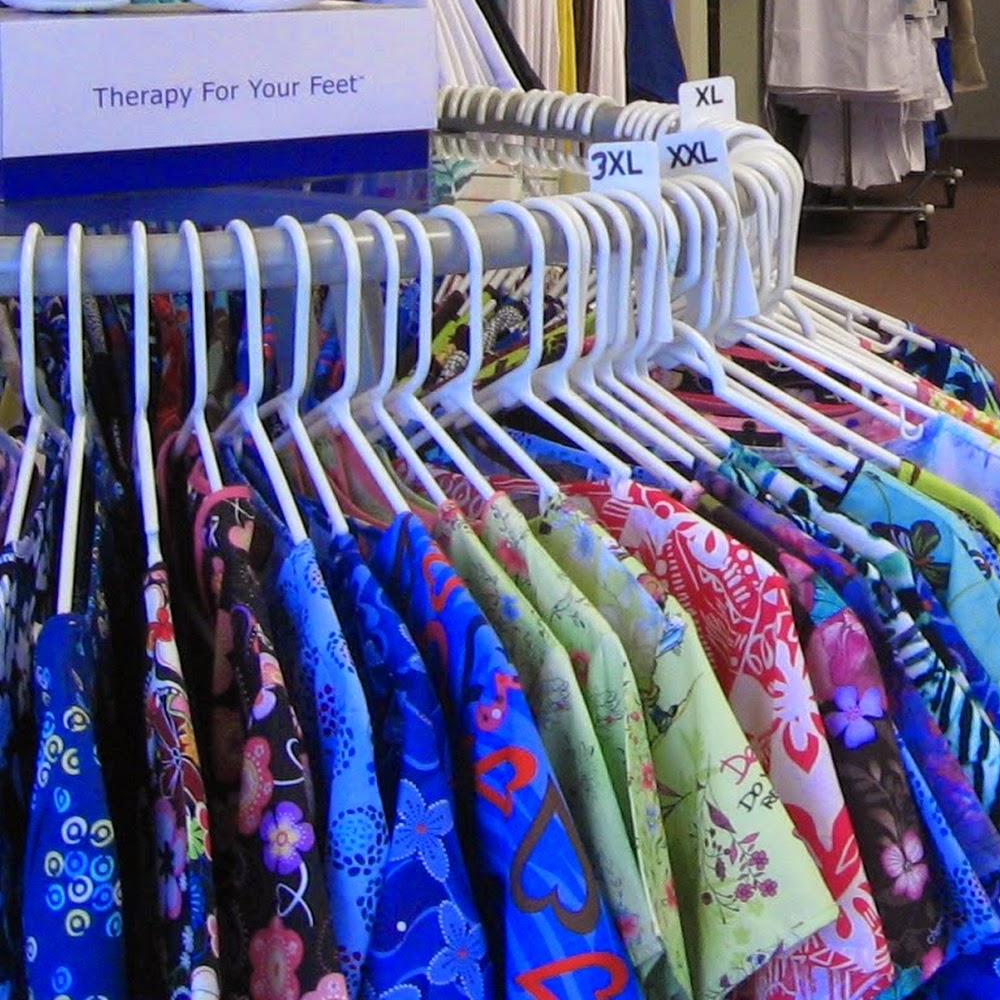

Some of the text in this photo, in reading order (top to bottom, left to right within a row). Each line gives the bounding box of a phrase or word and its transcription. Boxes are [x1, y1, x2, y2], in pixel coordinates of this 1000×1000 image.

[93, 86, 192, 109] Therapy
[202, 82, 239, 101] For
[248, 78, 301, 99] Your
[695, 85, 723, 108] XL
[591, 150, 643, 180] 3XL
[666, 141, 718, 169] XXL
